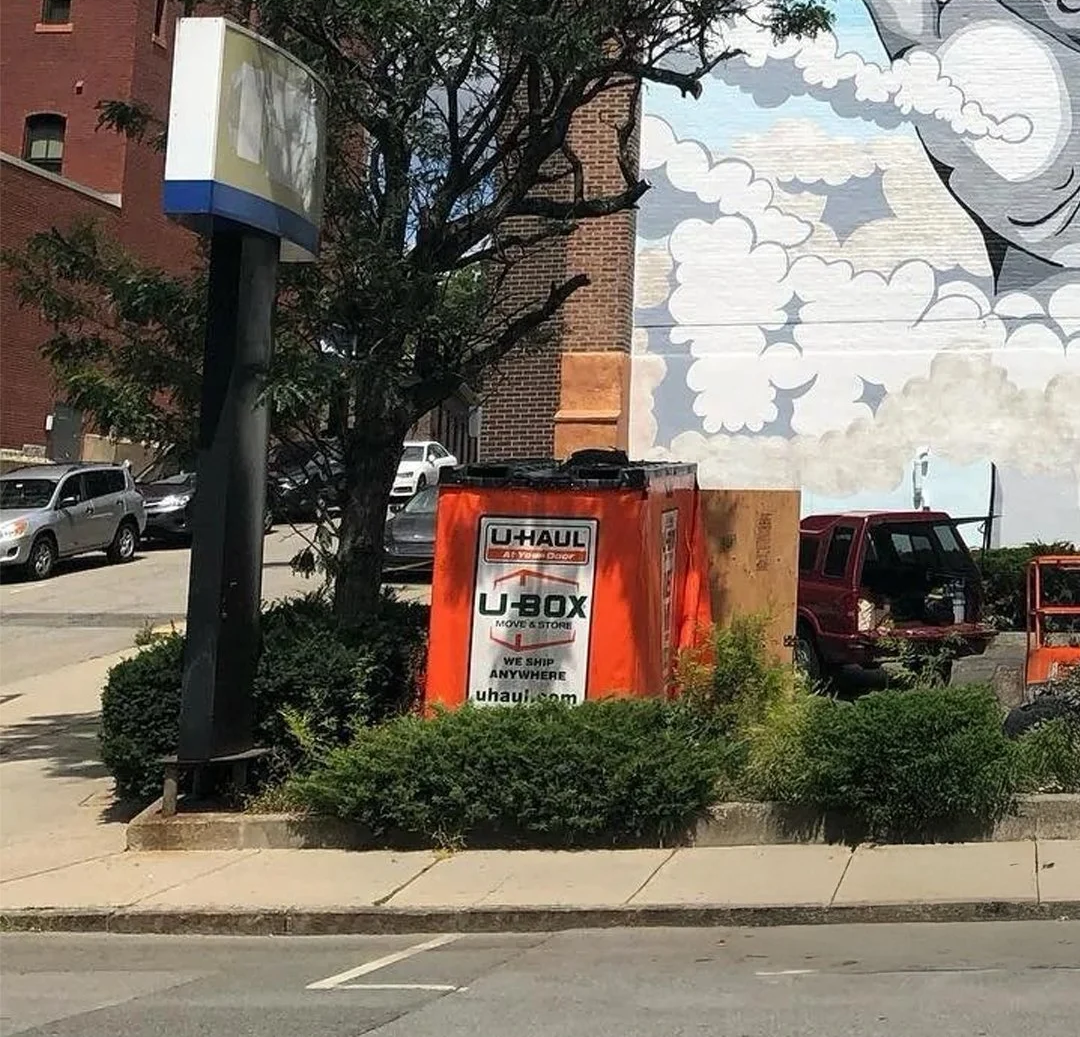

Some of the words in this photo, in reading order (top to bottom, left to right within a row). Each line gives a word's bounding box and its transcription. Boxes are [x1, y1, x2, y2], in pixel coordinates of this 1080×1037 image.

[490, 528, 586, 548] U-HAUL
[502, 550, 515, 559] At
[546, 551, 576, 561] Door
[478, 592, 588, 619] U-BOX
[495, 620, 527, 629] MOVE
[528, 621, 536, 629] &
[537, 621, 573, 630] STORE
[503, 656, 522, 667] WE
[525, 657, 555, 668] SHIP
[489, 669, 567, 681] ANYWHERE
